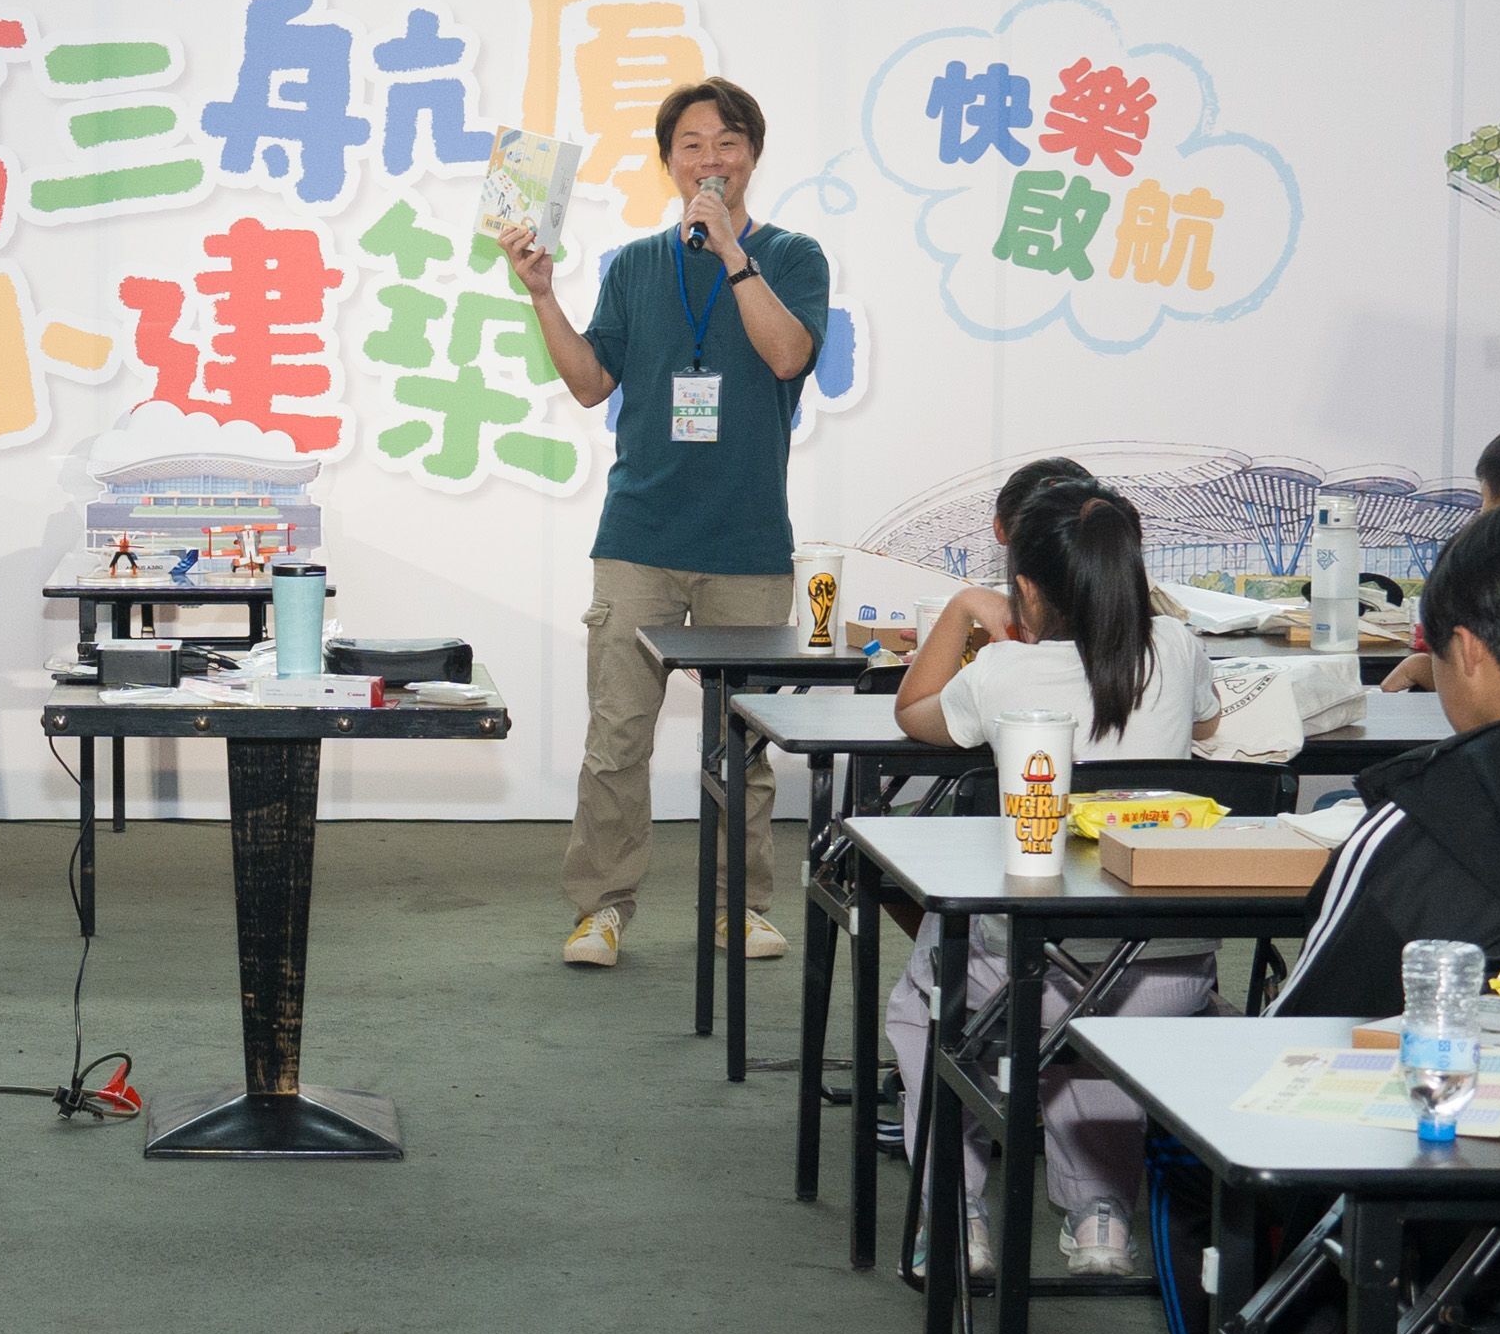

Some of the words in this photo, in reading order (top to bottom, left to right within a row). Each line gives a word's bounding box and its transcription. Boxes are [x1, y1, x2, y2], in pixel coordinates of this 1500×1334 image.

[926, 57, 1157, 178] 快樂
[991, 169, 1226, 293] 啟航
[1026, 782, 1053, 797] FIFA
[1003, 792, 1072, 818] WORLD
[1015, 817, 1059, 842] CUP
[1021, 840, 1053, 855] MEAL
